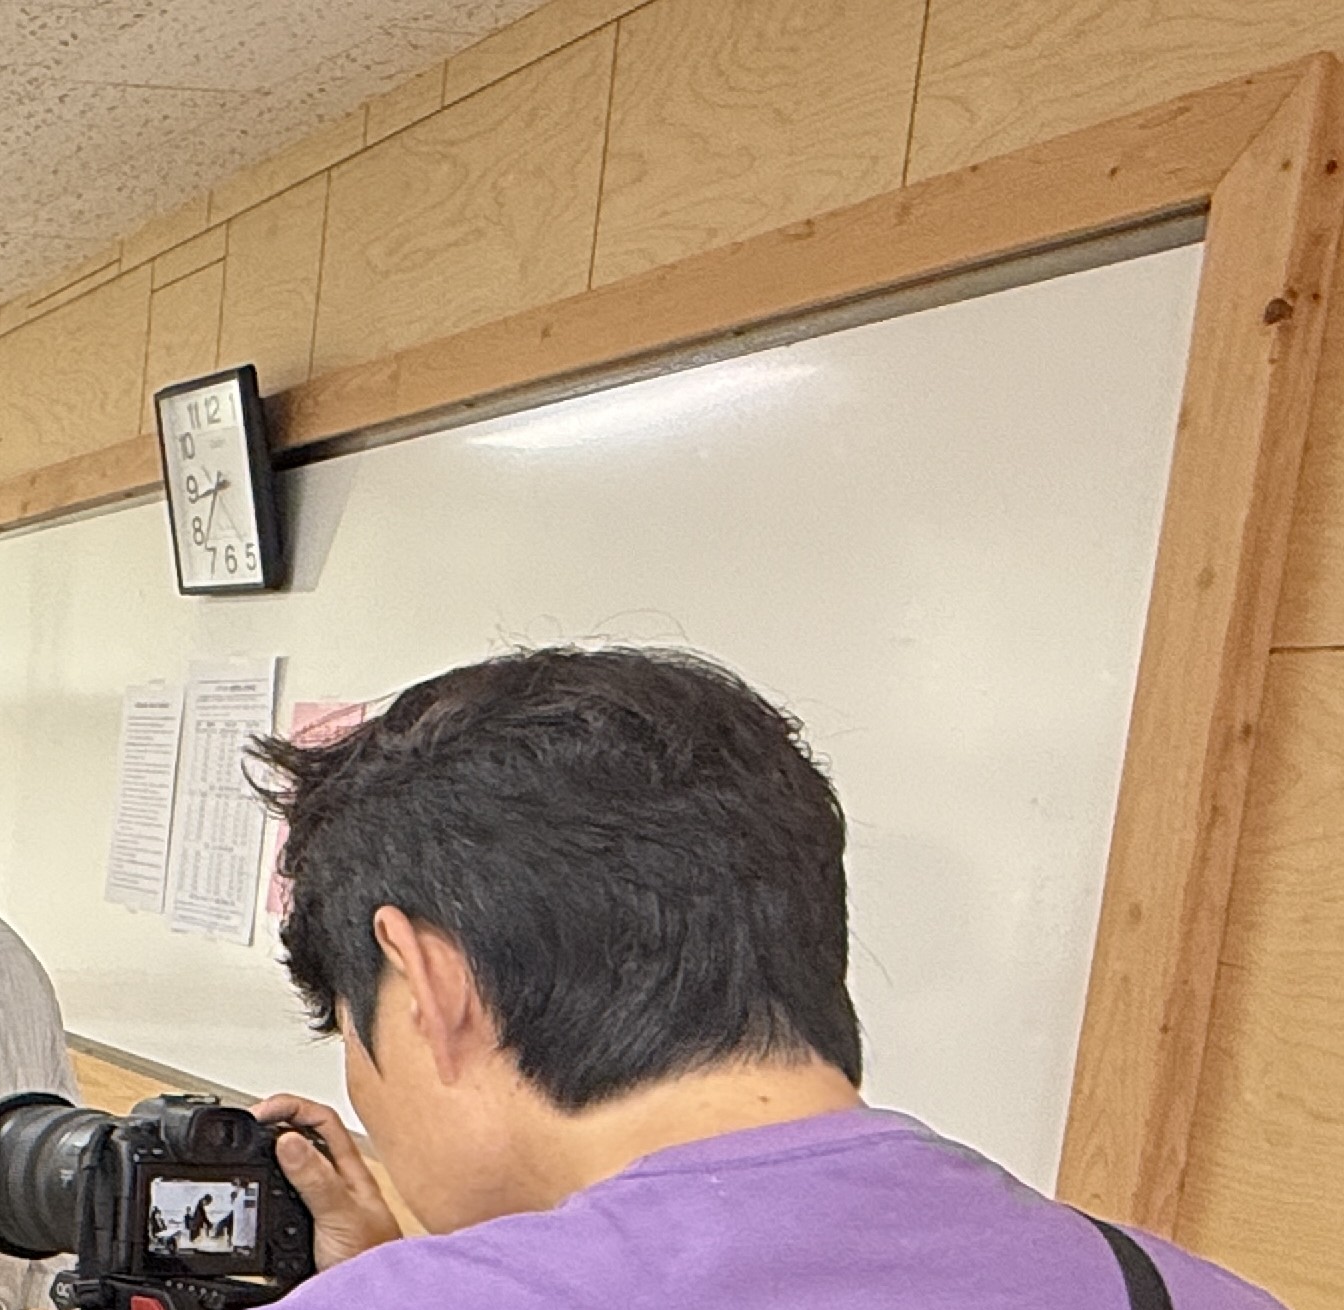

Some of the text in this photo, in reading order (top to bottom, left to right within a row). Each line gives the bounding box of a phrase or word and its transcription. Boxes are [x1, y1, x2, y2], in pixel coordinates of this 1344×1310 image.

[187, 392, 237, 430] 11 12 1
[179, 431, 196, 461] 10
[186, 474, 200, 504] 9
[192, 515, 205, 546] 8
[205, 542, 257, 575] 7 6 5
